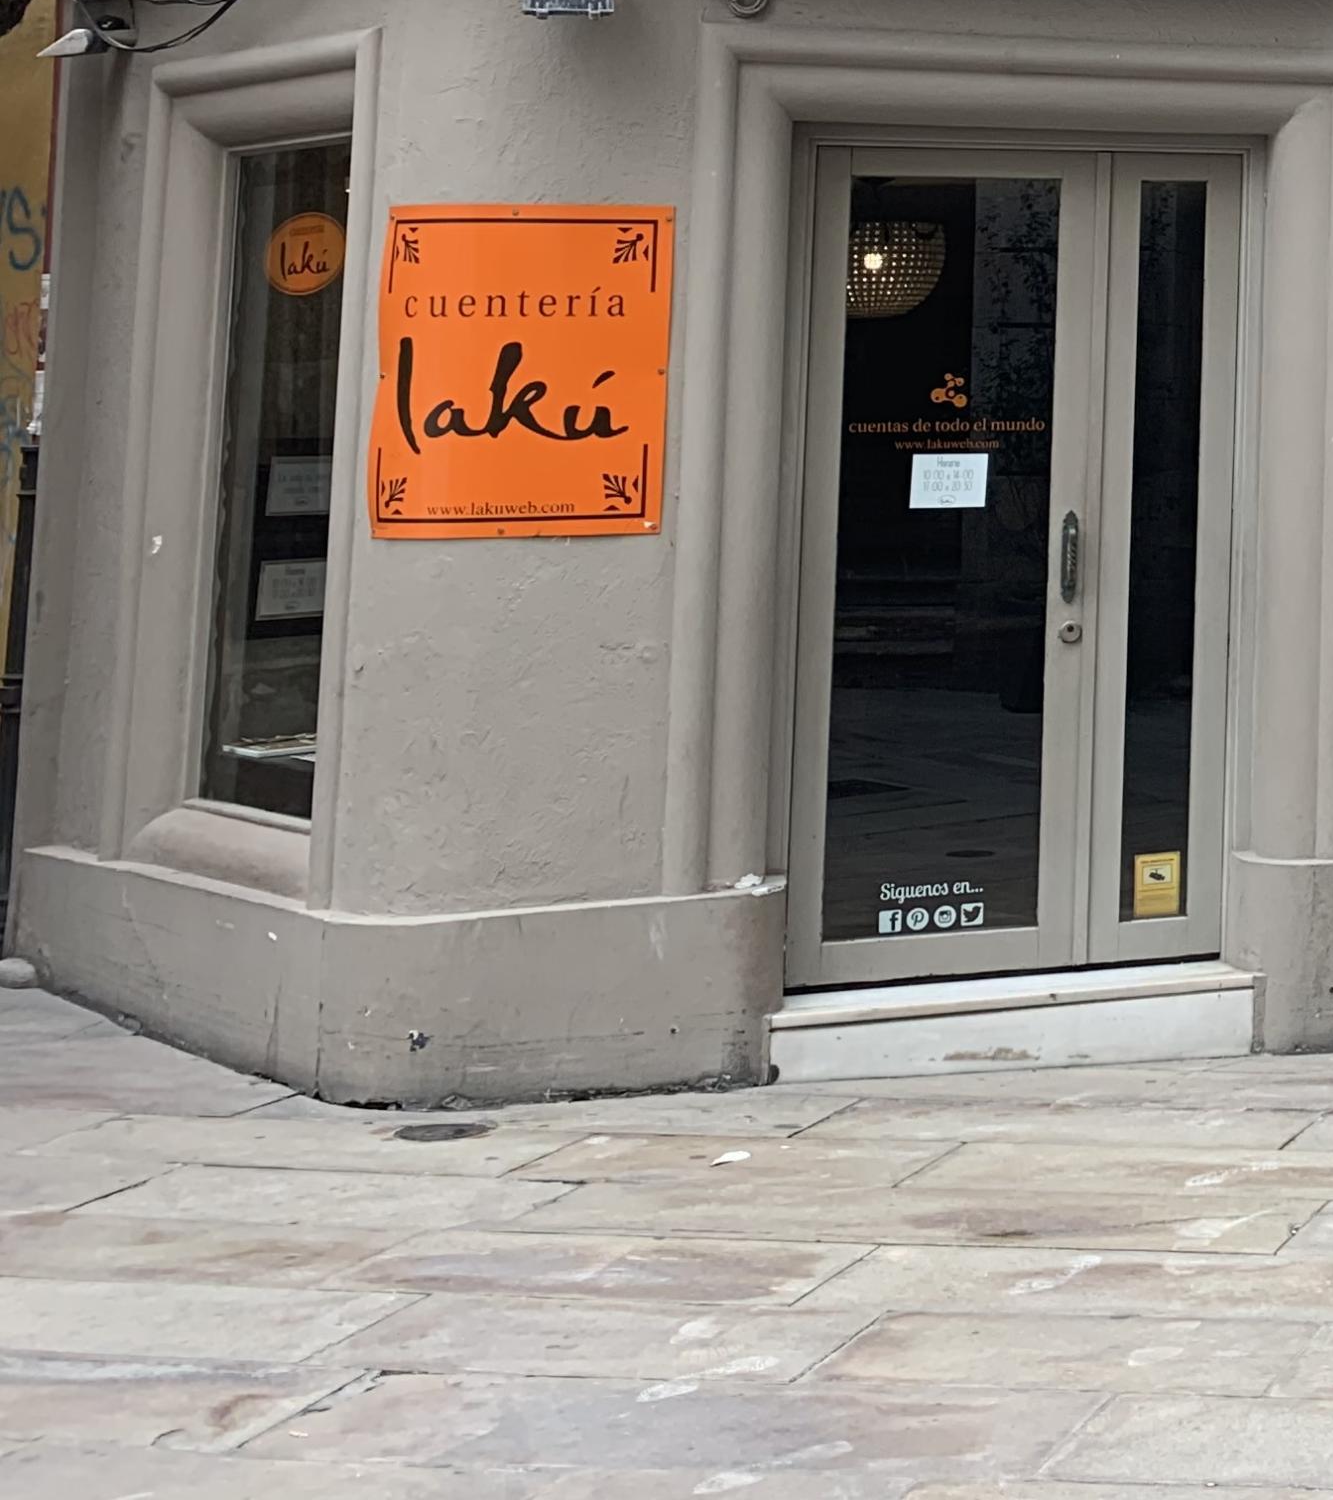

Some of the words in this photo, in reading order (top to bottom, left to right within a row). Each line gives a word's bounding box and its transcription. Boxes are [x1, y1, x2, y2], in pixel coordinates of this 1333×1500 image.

[280, 241, 330, 280] lakú
[404, 287, 626, 318] cuentería
[396, 336, 630, 456] lakú
[848, 420, 909, 434] cuentas
[912, 419, 932, 433] de
[935, 417, 970, 432] todo
[973, 417, 987, 431] el
[991, 417, 1046, 432] mundo
[427, 501, 576, 517] www.lakuweb.com
[879, 881, 949, 904] Siguenos
